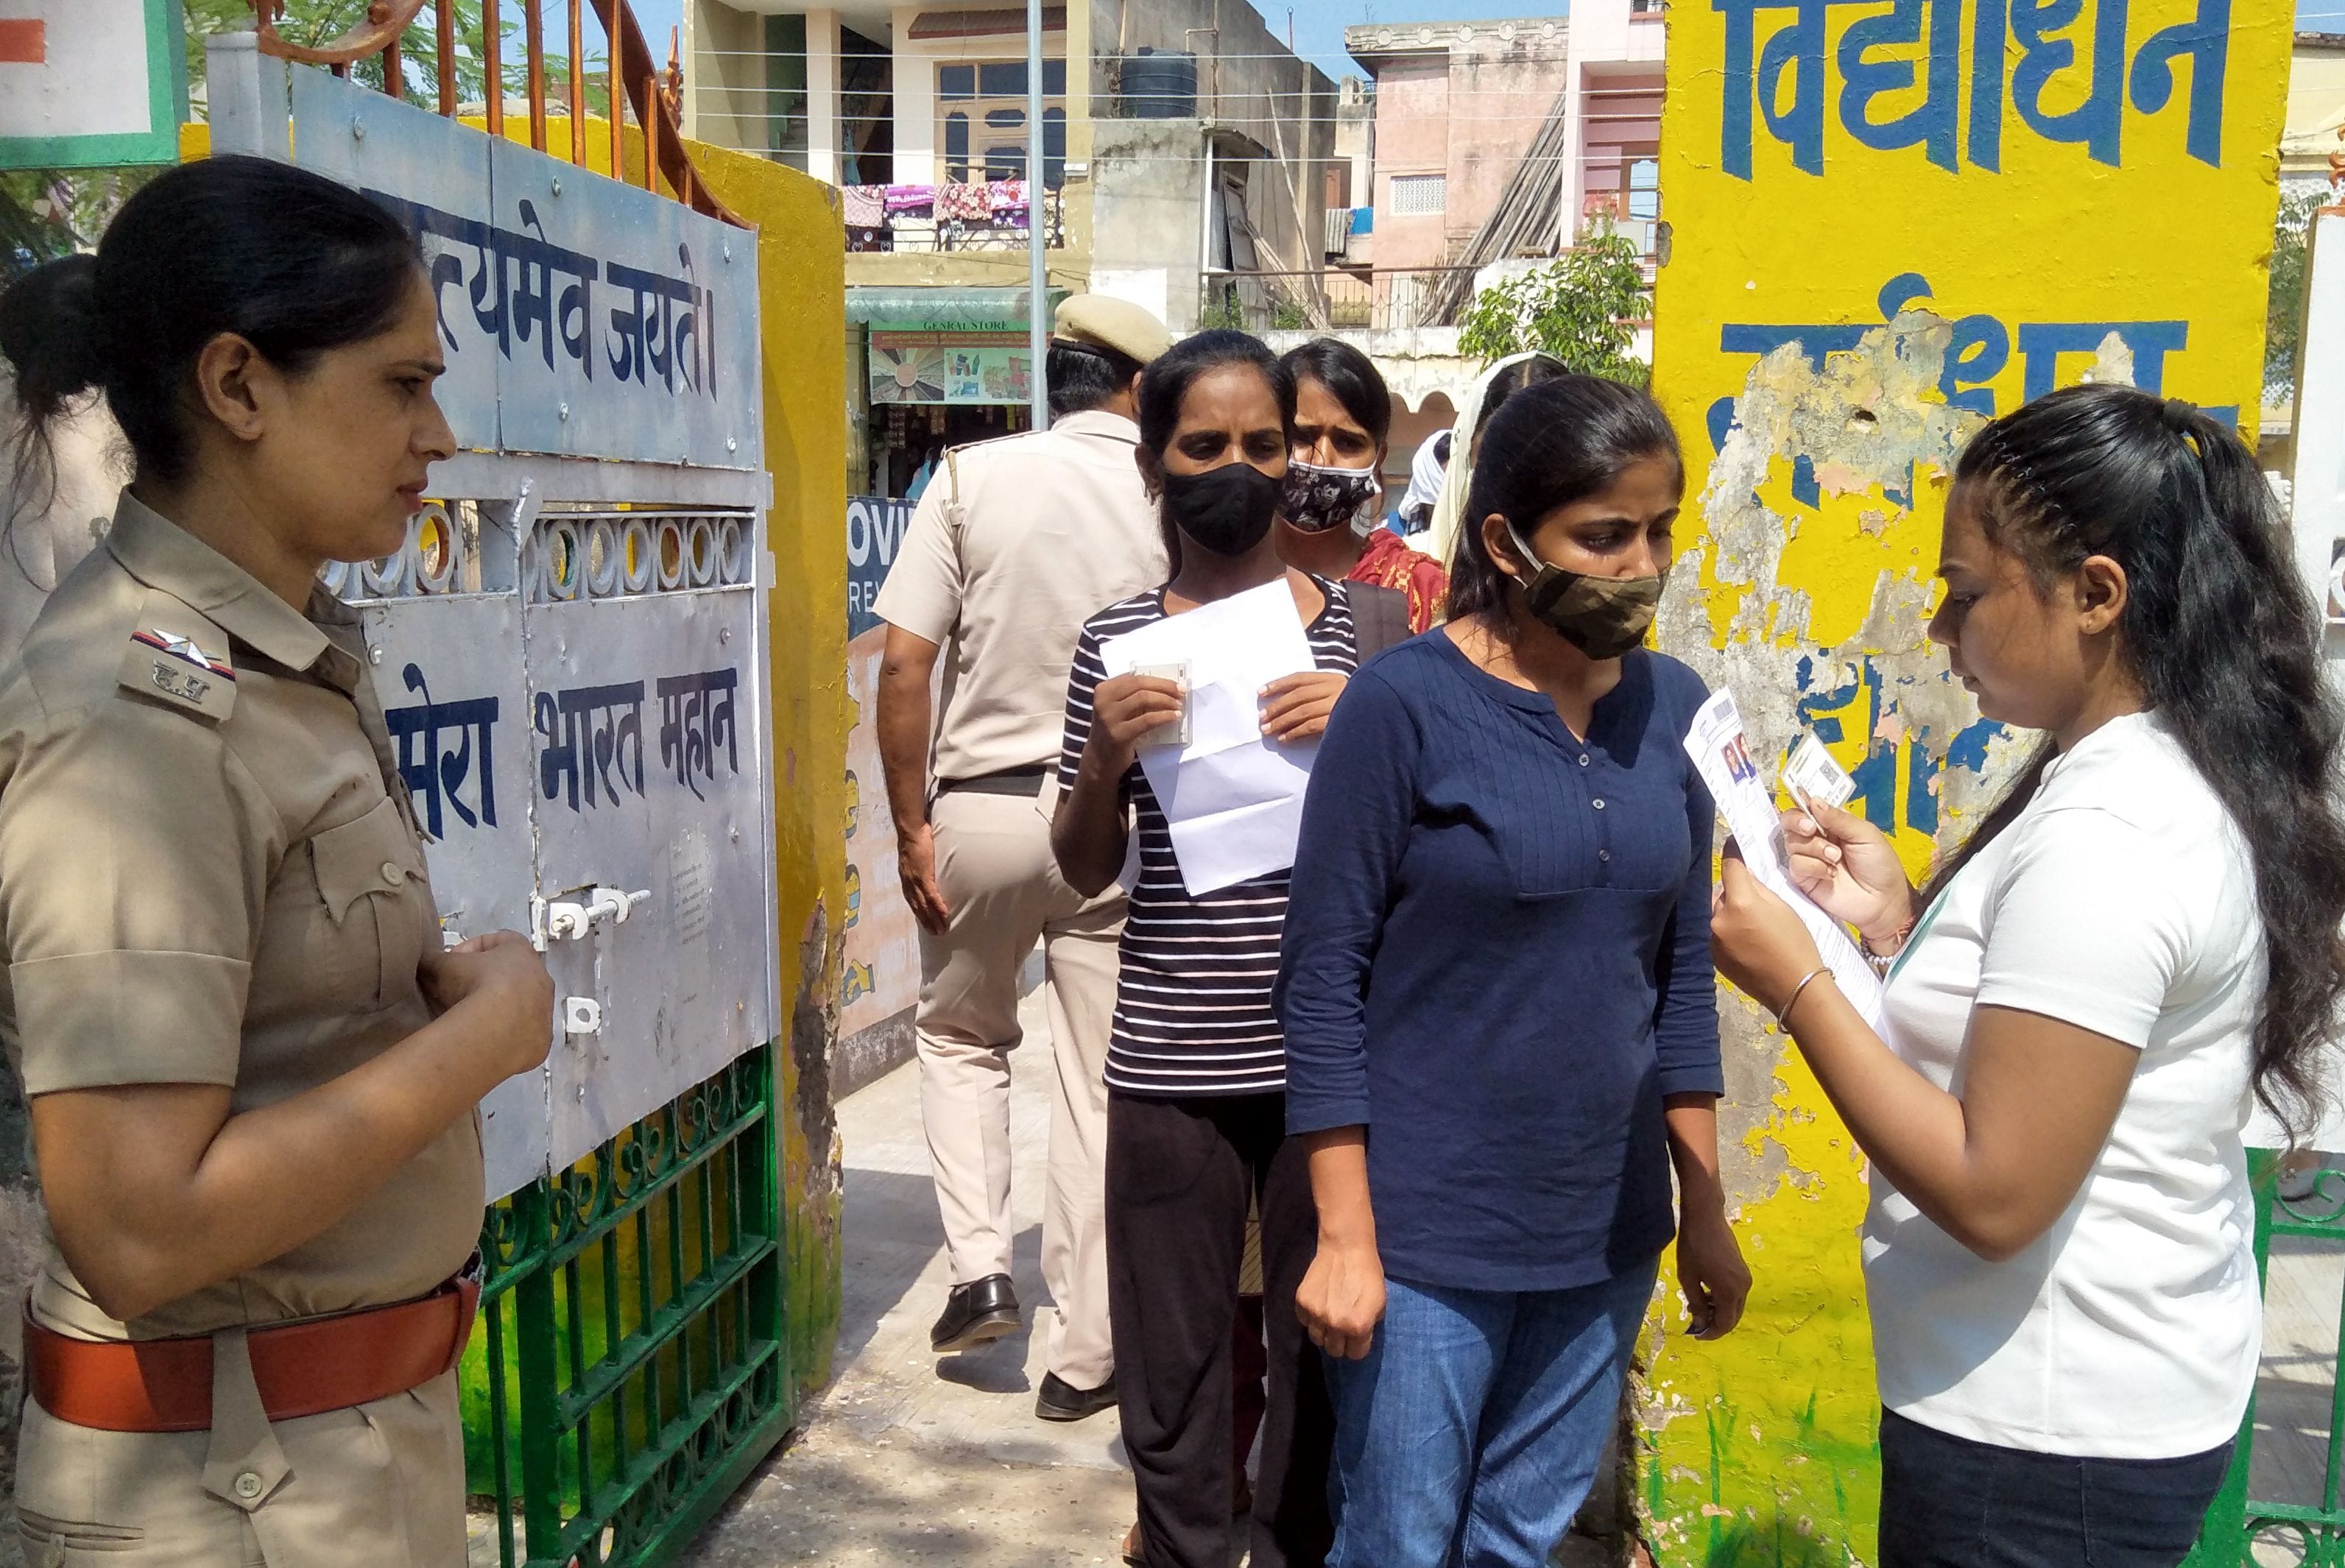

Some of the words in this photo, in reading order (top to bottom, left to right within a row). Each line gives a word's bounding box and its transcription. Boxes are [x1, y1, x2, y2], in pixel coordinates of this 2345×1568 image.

[360, 188, 598, 383] त्यमेव
[923, 321, 969, 331] GENRAL
[970, 320, 1009, 331] STORE
[847, 501, 916, 567] OVI
[385, 663, 498, 840] मेरा
[535, 680, 645, 813] भारत
[657, 668, 738, 802] महान
